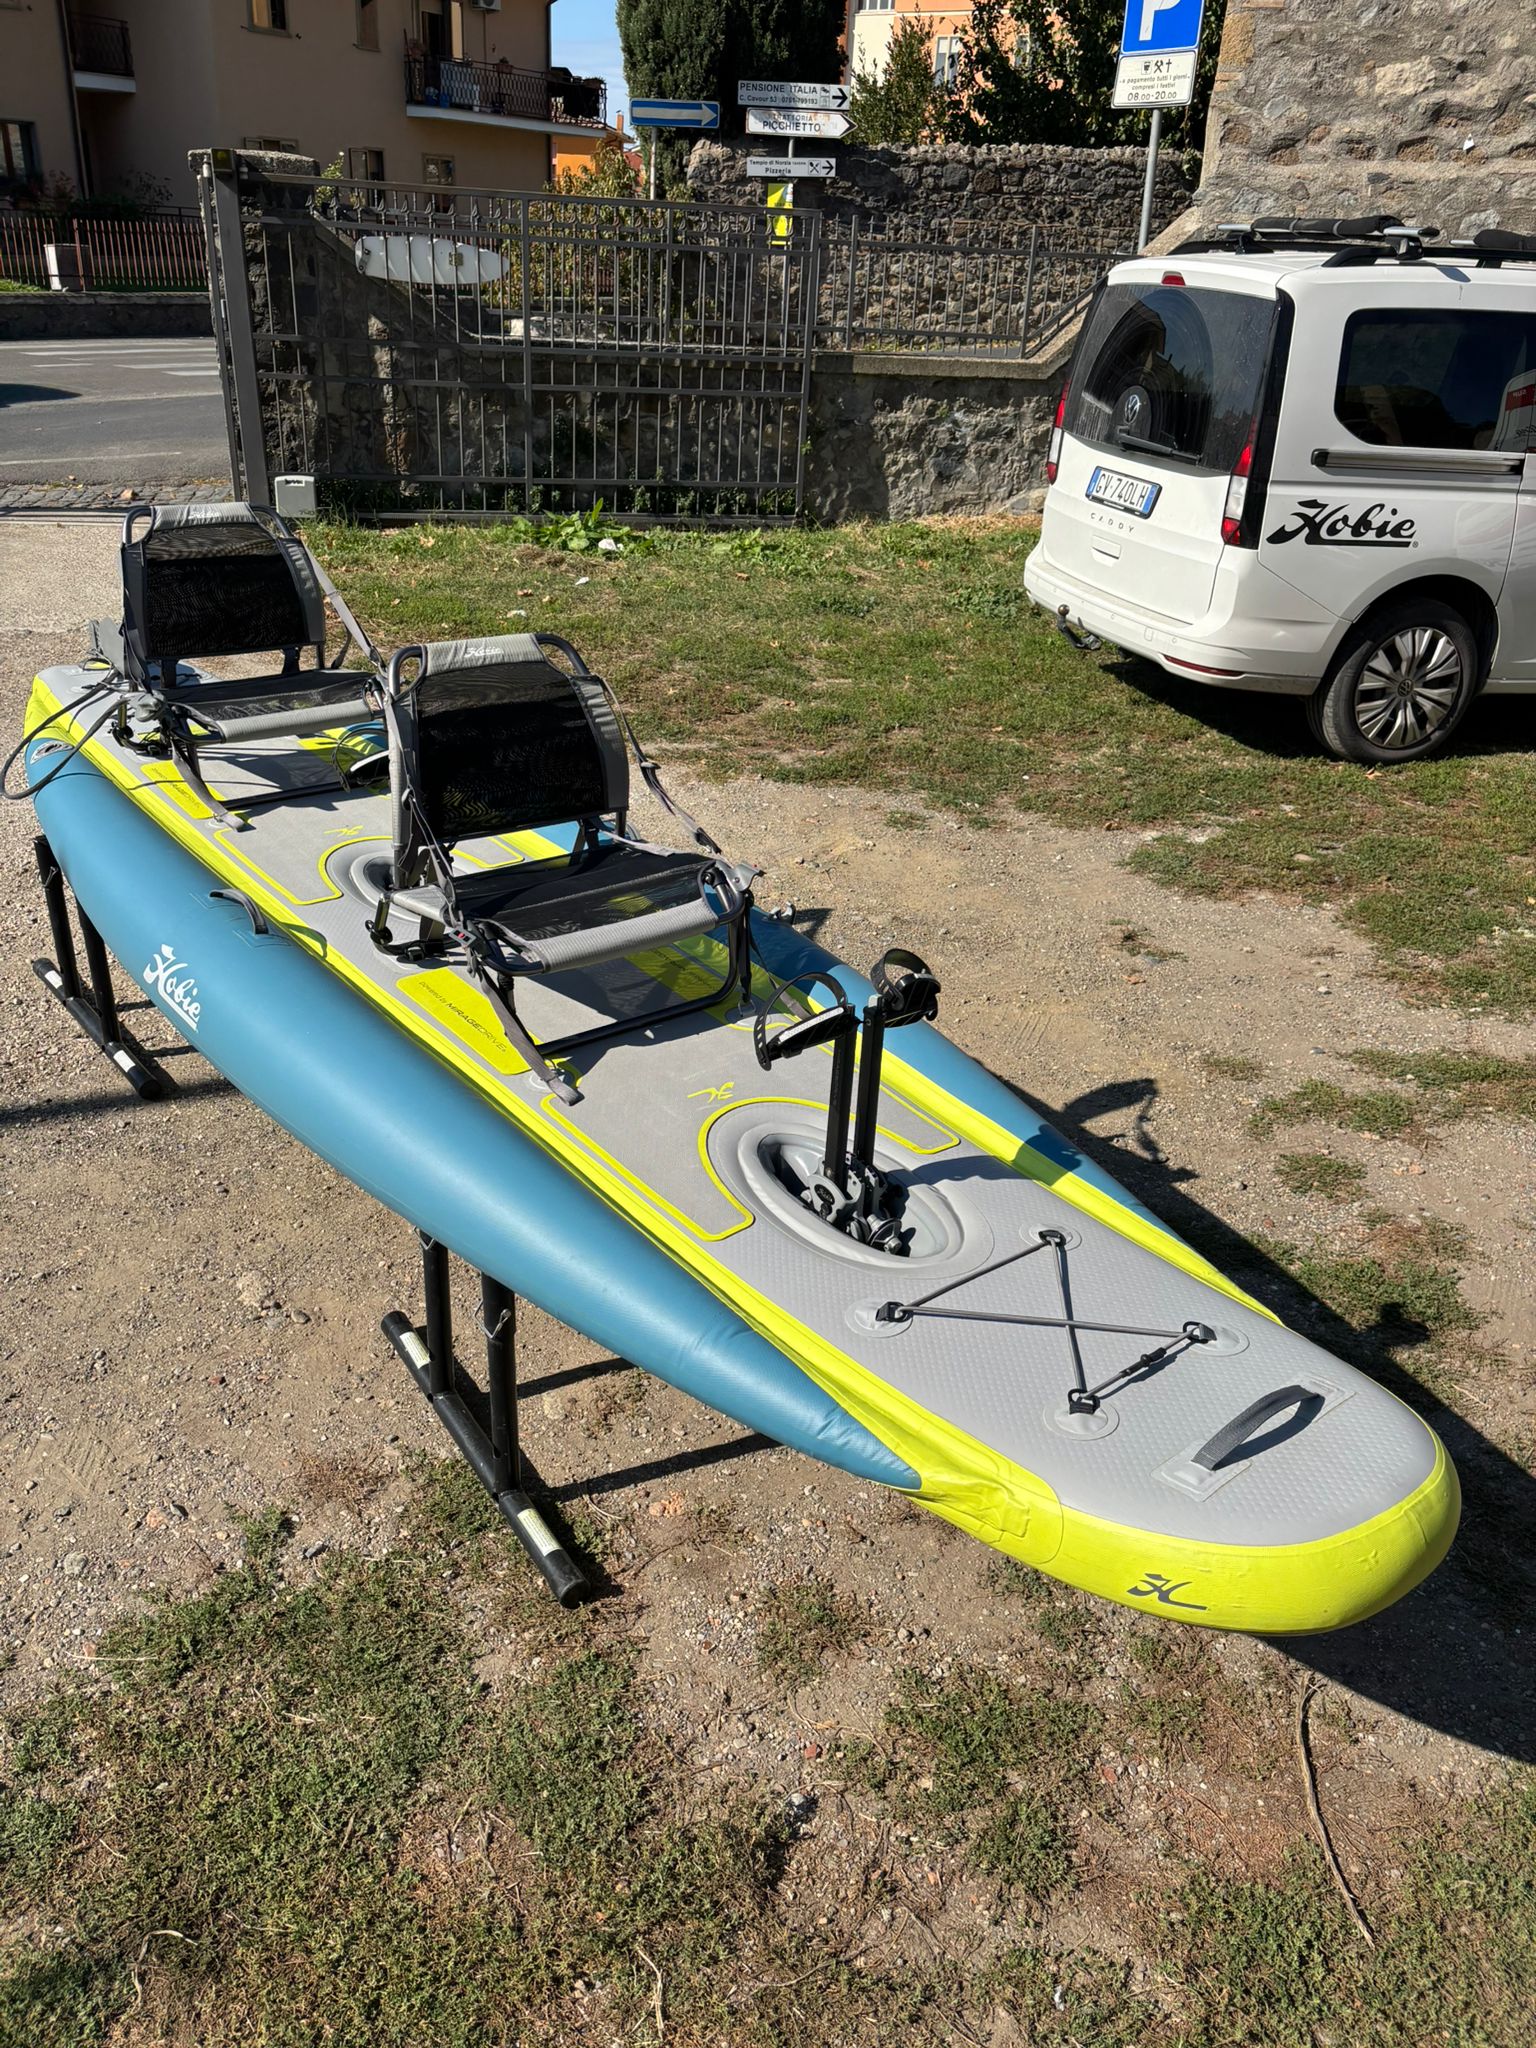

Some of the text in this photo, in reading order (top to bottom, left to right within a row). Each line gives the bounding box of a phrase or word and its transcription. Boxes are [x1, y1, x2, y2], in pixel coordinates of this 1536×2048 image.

[740, 82, 818, 94] PENSIONE ITALIA
[1090, 512, 1135, 533] CADDY
[1266, 499, 1417, 548] Hobie
[143, 943, 200, 1033] Hobie
